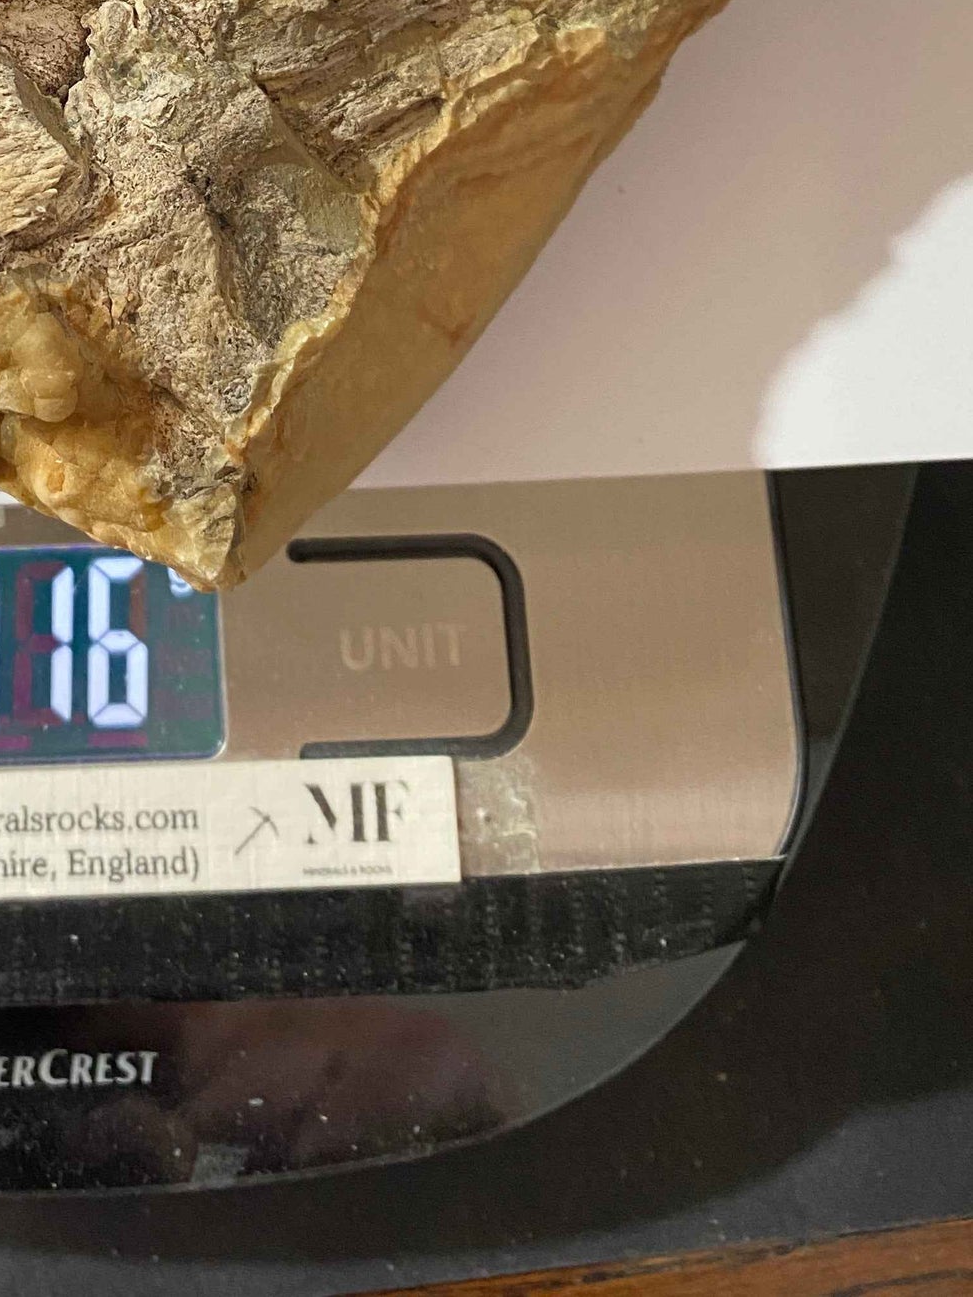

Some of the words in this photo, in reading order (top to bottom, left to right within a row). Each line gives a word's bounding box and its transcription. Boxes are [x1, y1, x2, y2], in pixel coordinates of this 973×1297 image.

[339, 623, 467, 670] UNIT
[303, 780, 411, 845] MF
[67, 846, 201, 883] England)
